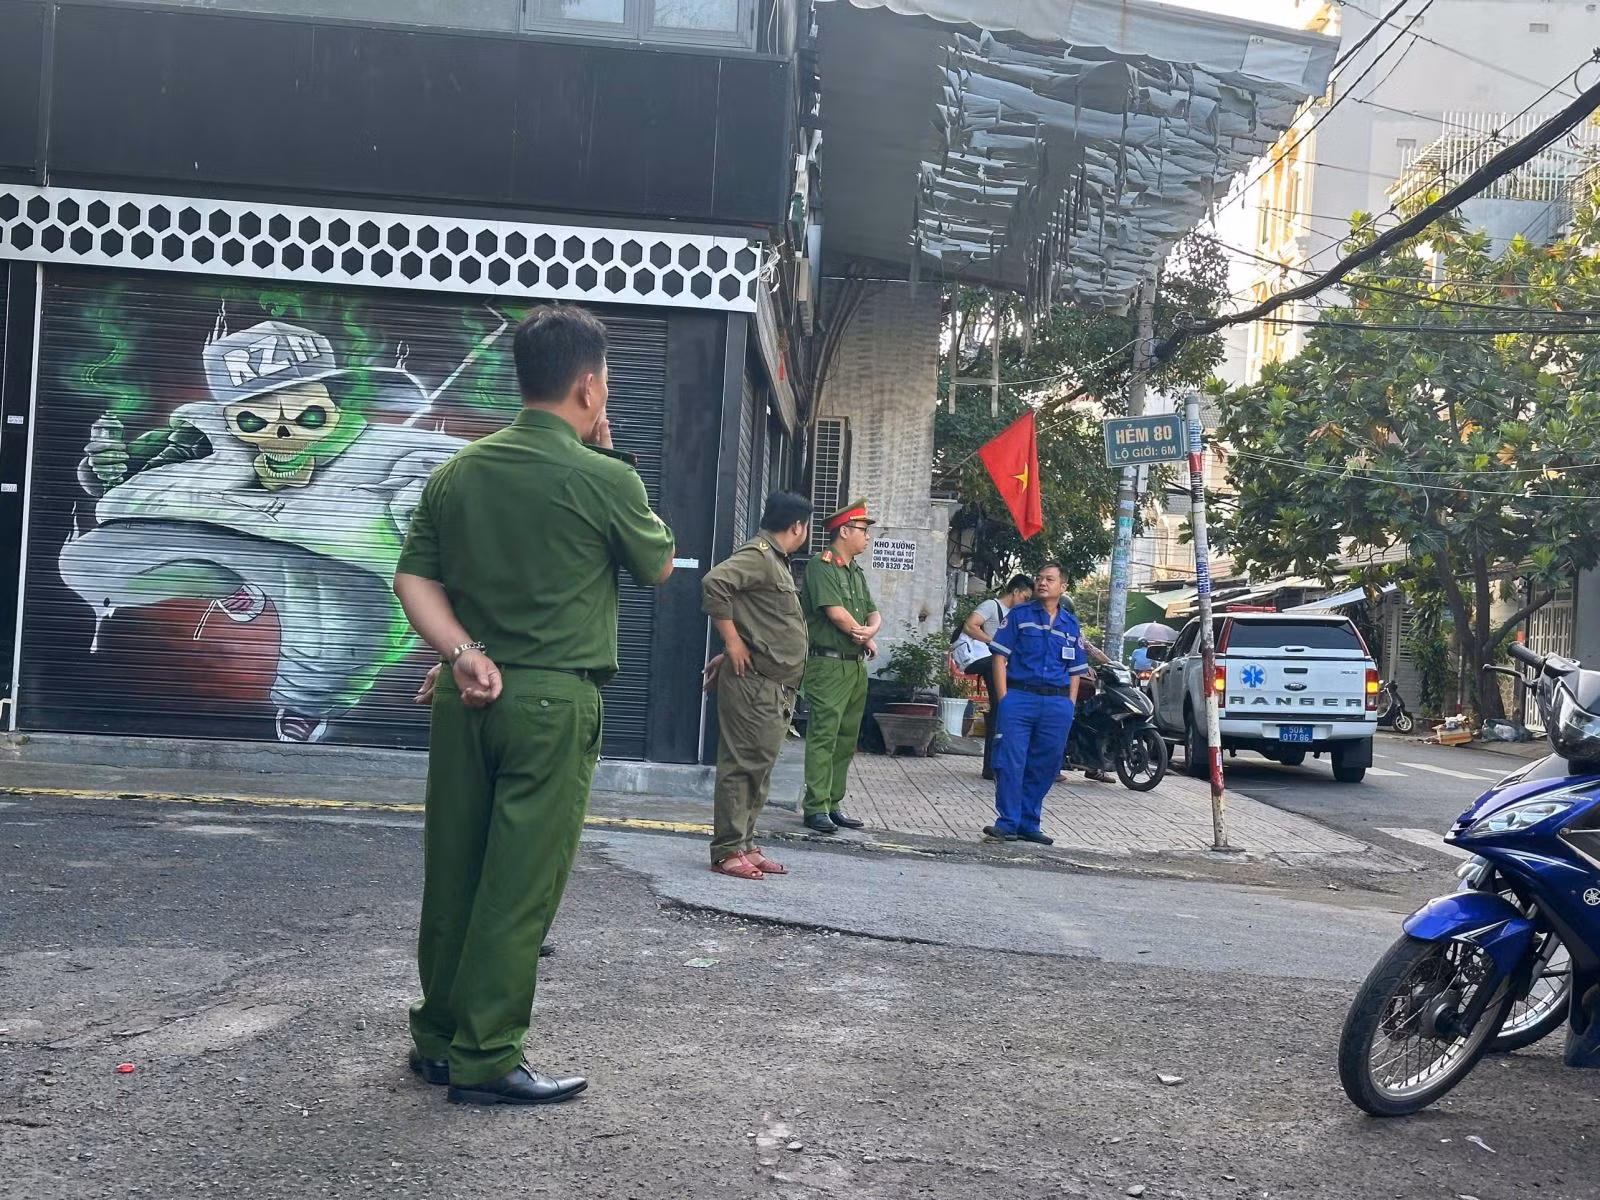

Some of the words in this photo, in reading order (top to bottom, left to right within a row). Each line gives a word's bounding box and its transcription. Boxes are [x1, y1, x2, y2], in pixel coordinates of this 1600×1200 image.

[1115, 423, 1150, 445] HẺM
[1153, 425, 1173, 441] 80
[1161, 445, 1177, 455] 6M
[885, 562, 901, 570] 8320
[1228, 696, 1362, 707] RANGER
